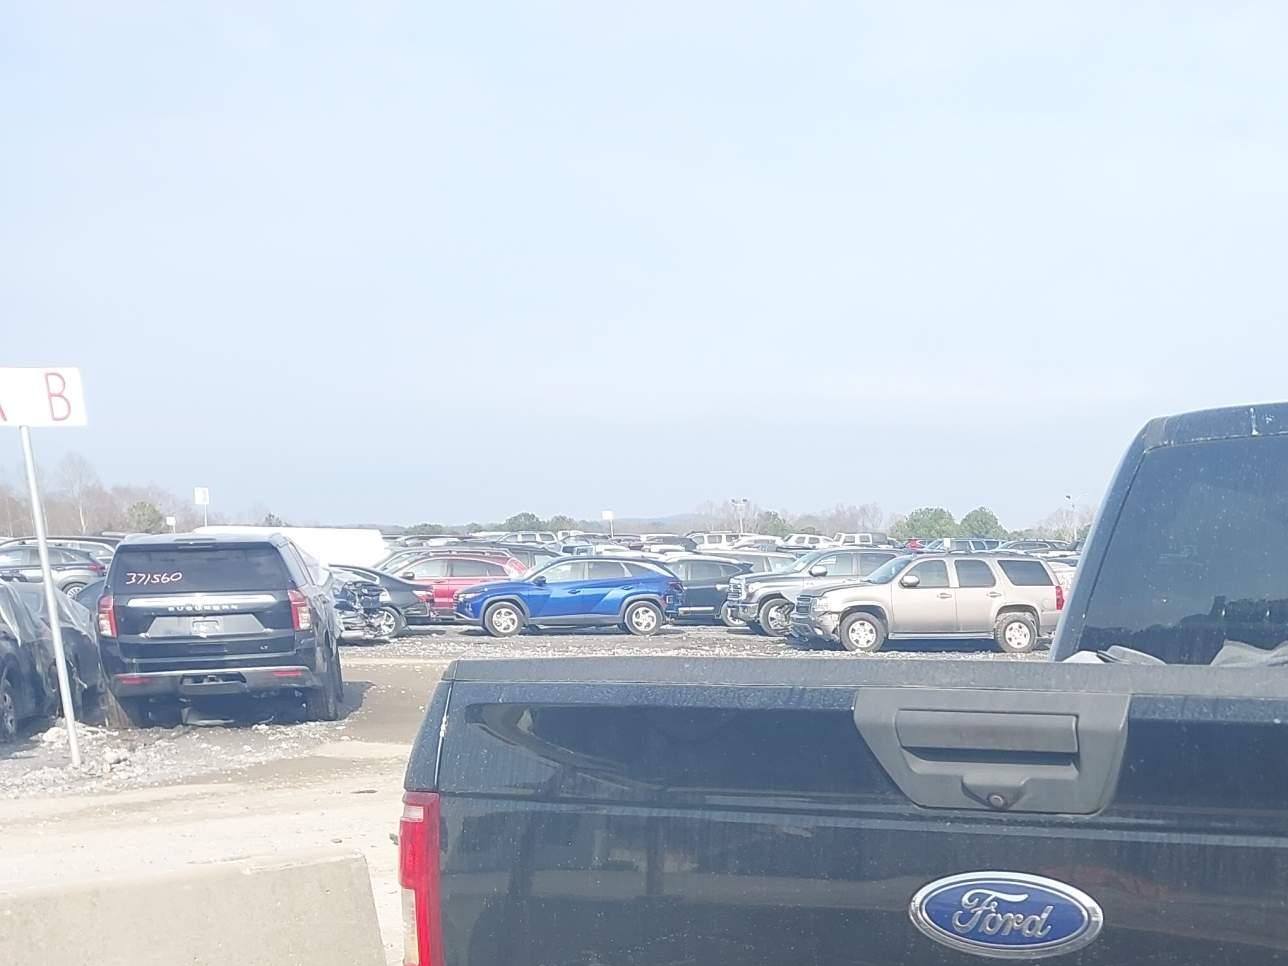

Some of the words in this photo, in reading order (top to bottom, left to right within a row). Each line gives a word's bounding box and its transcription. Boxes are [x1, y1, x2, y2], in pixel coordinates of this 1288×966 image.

[45, 372, 72, 421] B
[125, 571, 183, 585] 371560
[952, 889, 1054, 938] Ford
